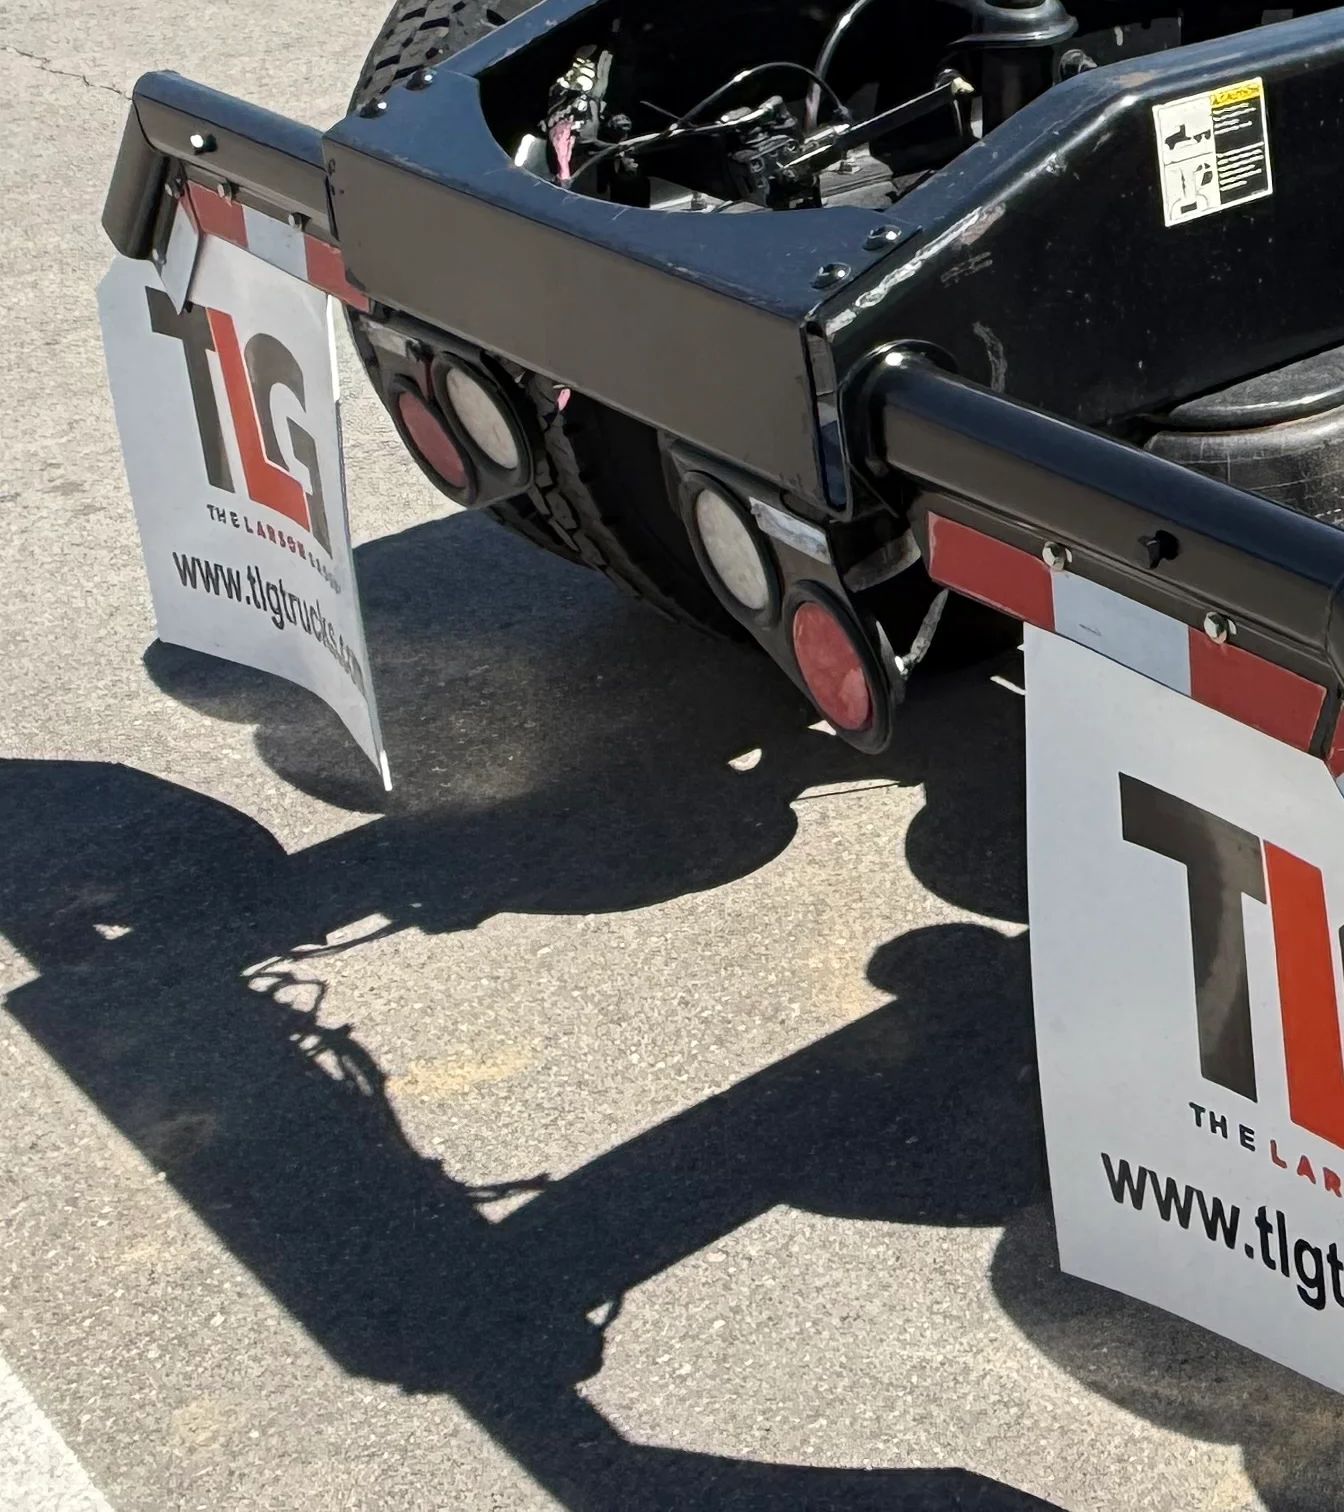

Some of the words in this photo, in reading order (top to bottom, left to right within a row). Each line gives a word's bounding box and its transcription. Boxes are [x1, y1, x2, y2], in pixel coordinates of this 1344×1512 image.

[145, 285, 333, 561] TLG
[207, 503, 240, 529] THE
[243, 516, 307, 561] LARSON
[1188, 1101, 1256, 1152] THE
